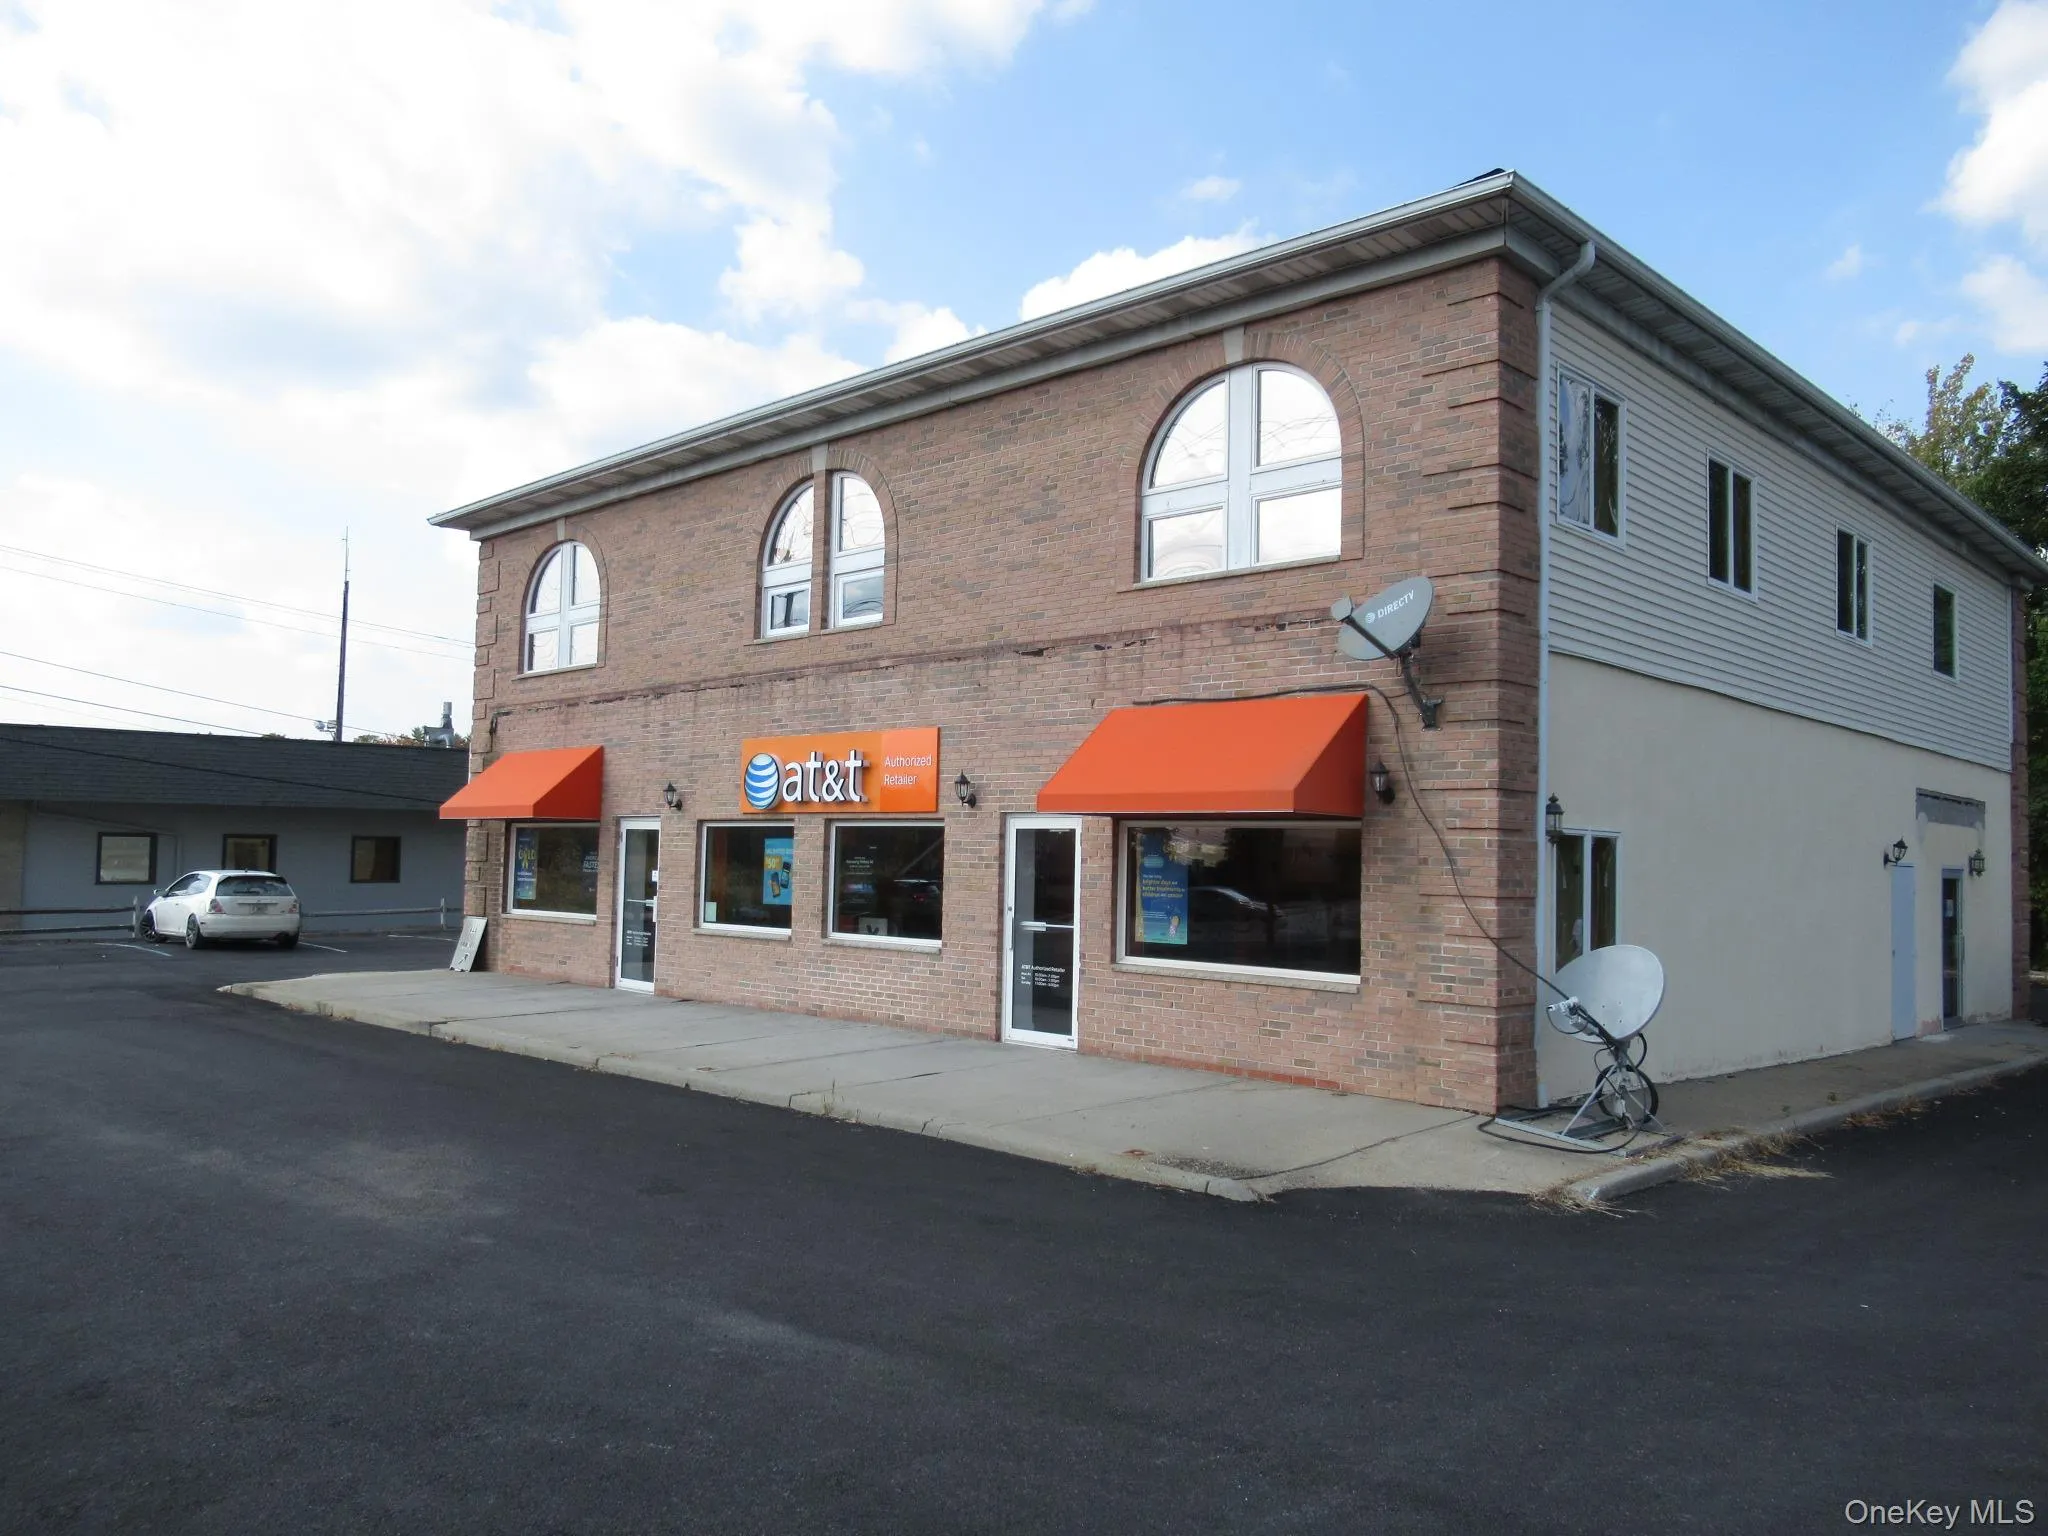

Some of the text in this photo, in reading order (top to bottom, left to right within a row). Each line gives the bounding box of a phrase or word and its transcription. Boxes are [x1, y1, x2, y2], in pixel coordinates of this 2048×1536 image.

[1377, 589, 1414, 618] DIRECTV
[884, 755, 932, 767] Authorized
[782, 749, 862, 802] at&t
[884, 774, 917, 785] Retailer
